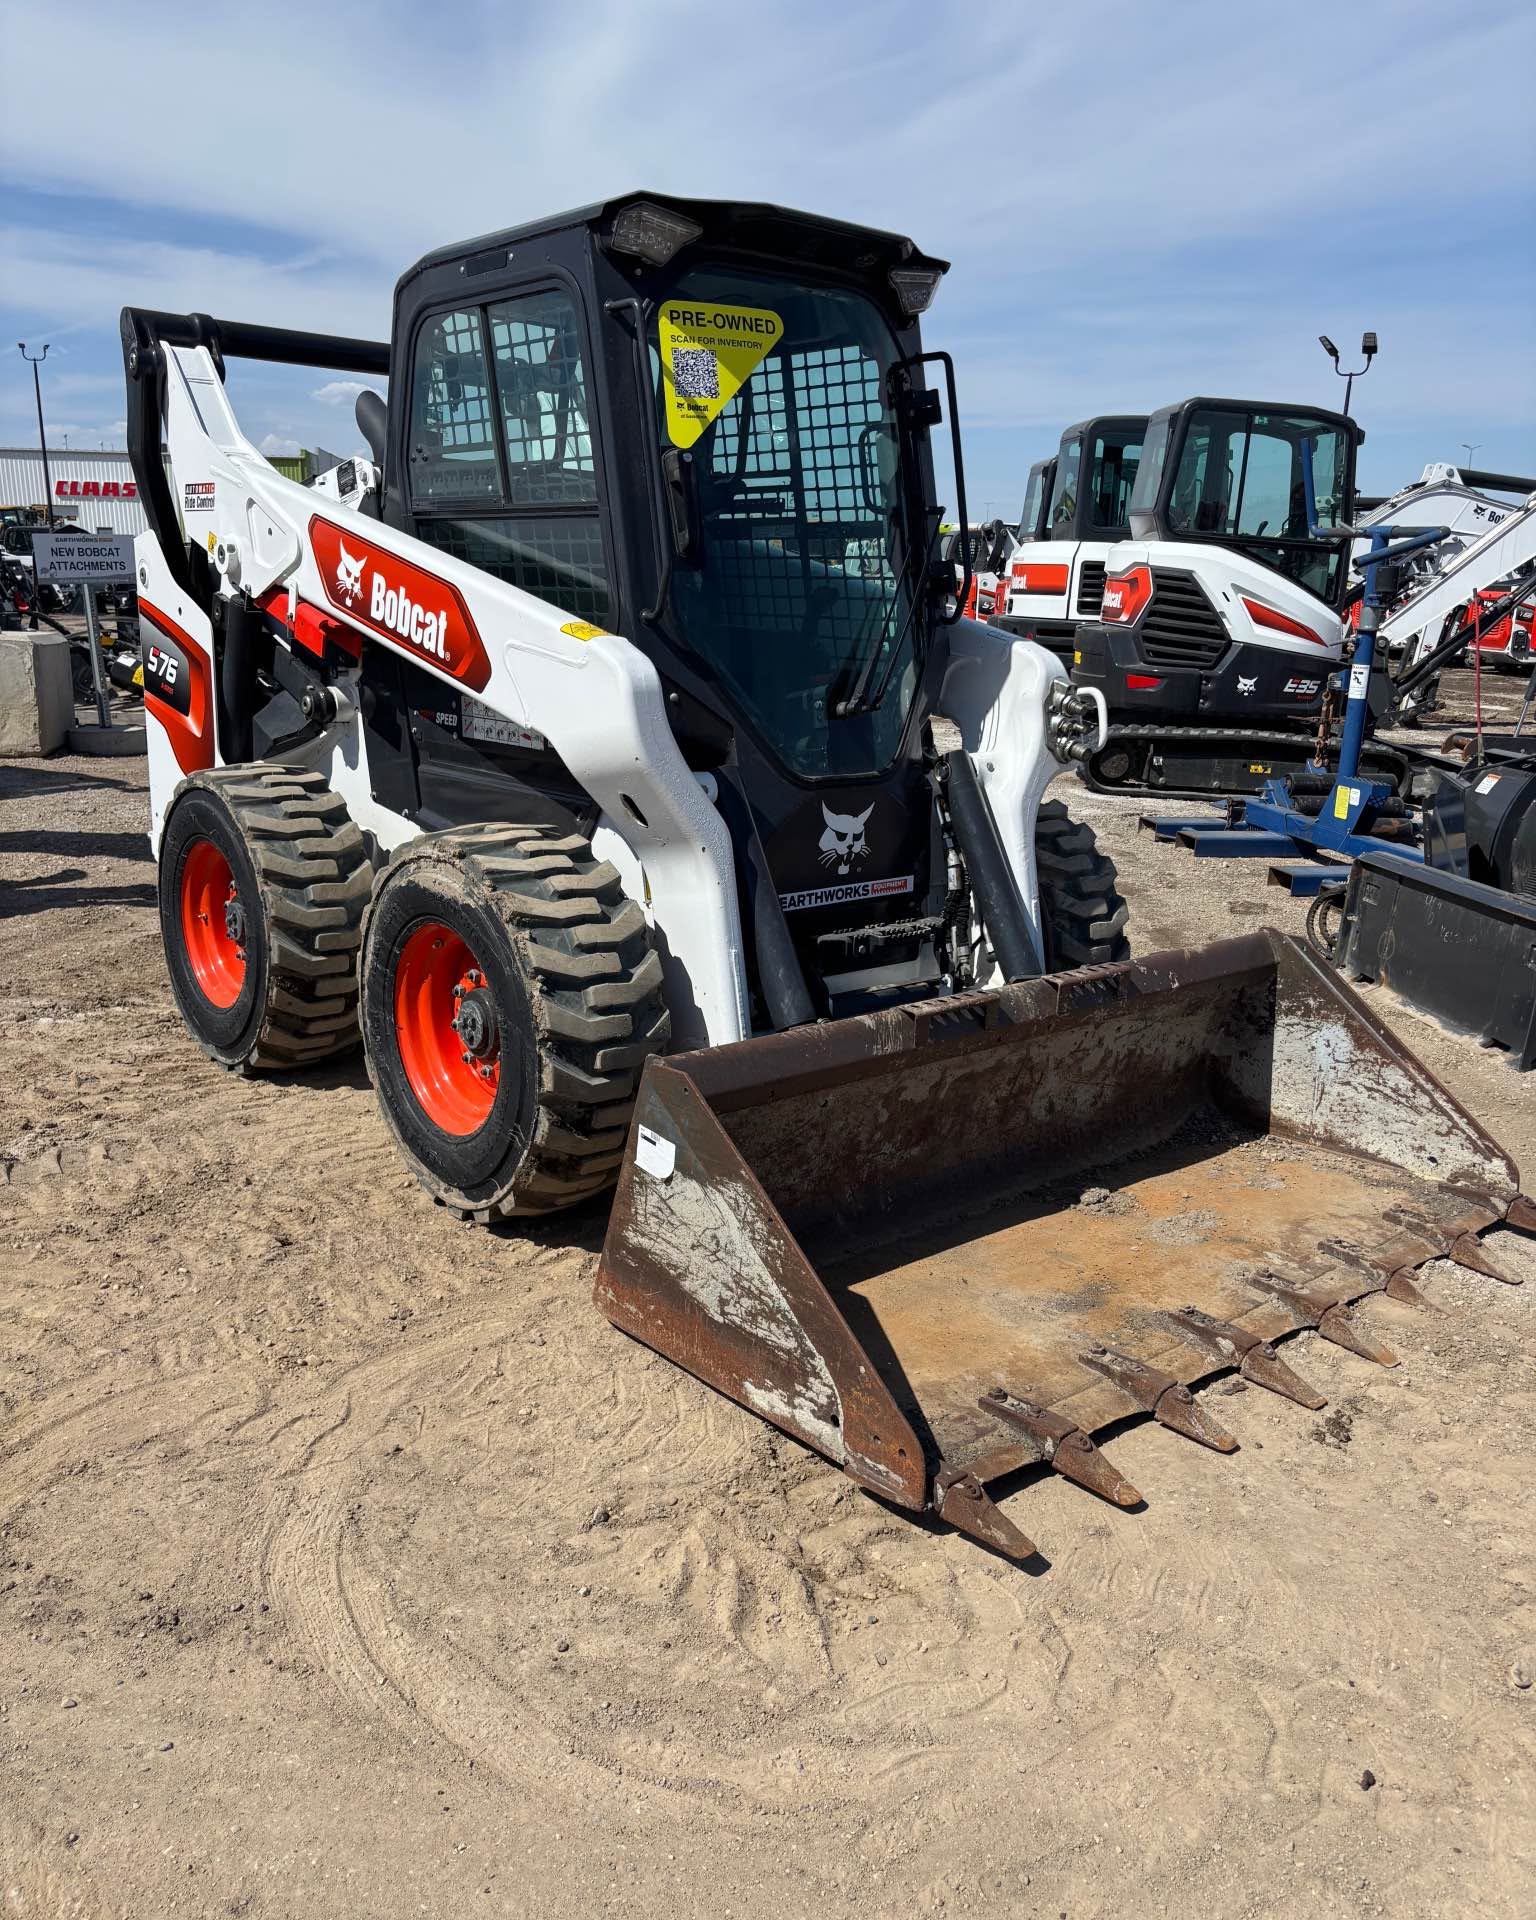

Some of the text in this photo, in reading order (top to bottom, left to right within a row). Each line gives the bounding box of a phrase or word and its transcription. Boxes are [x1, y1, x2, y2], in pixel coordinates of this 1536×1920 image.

[669, 309, 776, 335] PRE-OWNED
[670, 335, 763, 350] SCAN FOR INVENTORY
[55, 480, 137, 497] CLAAS
[184, 495, 215, 508] Ride Control
[51, 547, 121, 557] NEW BOBCAT
[49, 561, 127, 571] ATTACHMENTS
[371, 571, 448, 659] Bobcat
[147, 646, 179, 685] S76
[1283, 679, 1321, 694] E35
[435, 711, 458, 726] SPEED
[780, 884, 870, 910] EARTHWORKS
